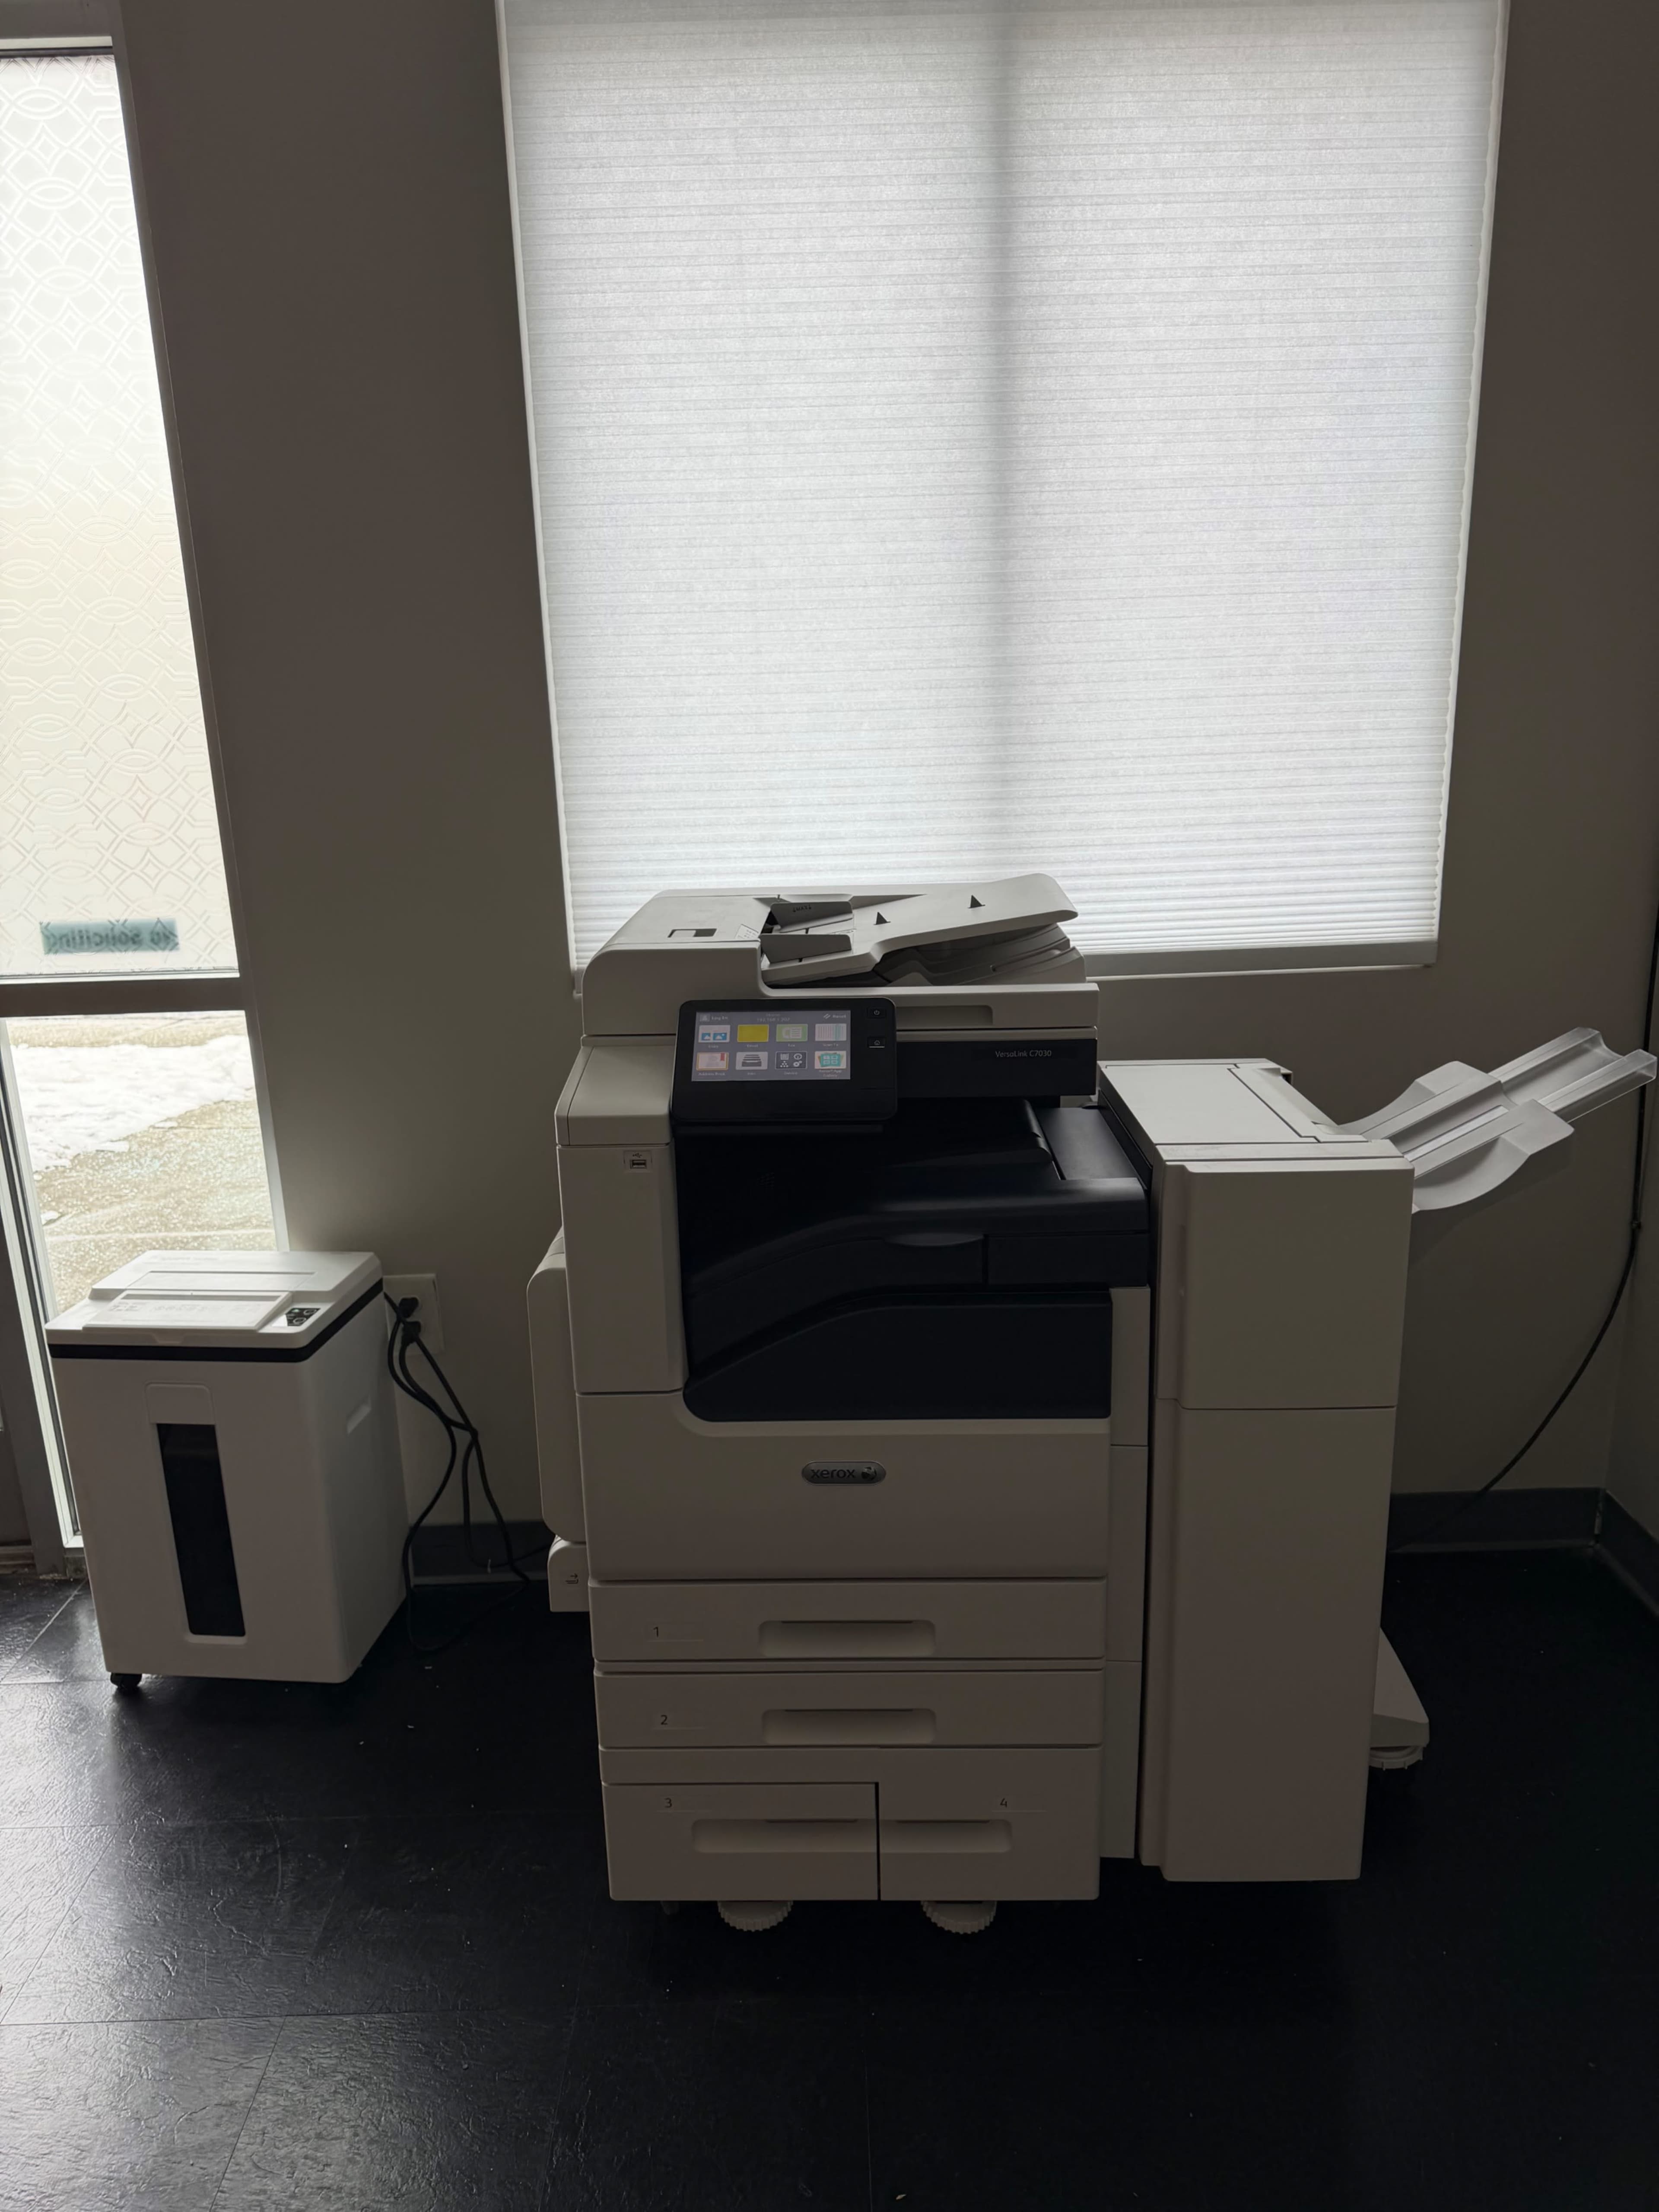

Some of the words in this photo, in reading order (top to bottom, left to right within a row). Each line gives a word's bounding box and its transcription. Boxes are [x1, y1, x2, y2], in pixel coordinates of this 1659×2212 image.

[811, 1469, 855, 1478] xerox
[653, 1626, 660, 1637] 1
[660, 1715, 668, 1726] 2
[664, 1798, 673, 1808] 3
[1000, 1798, 1007, 1808] 4
